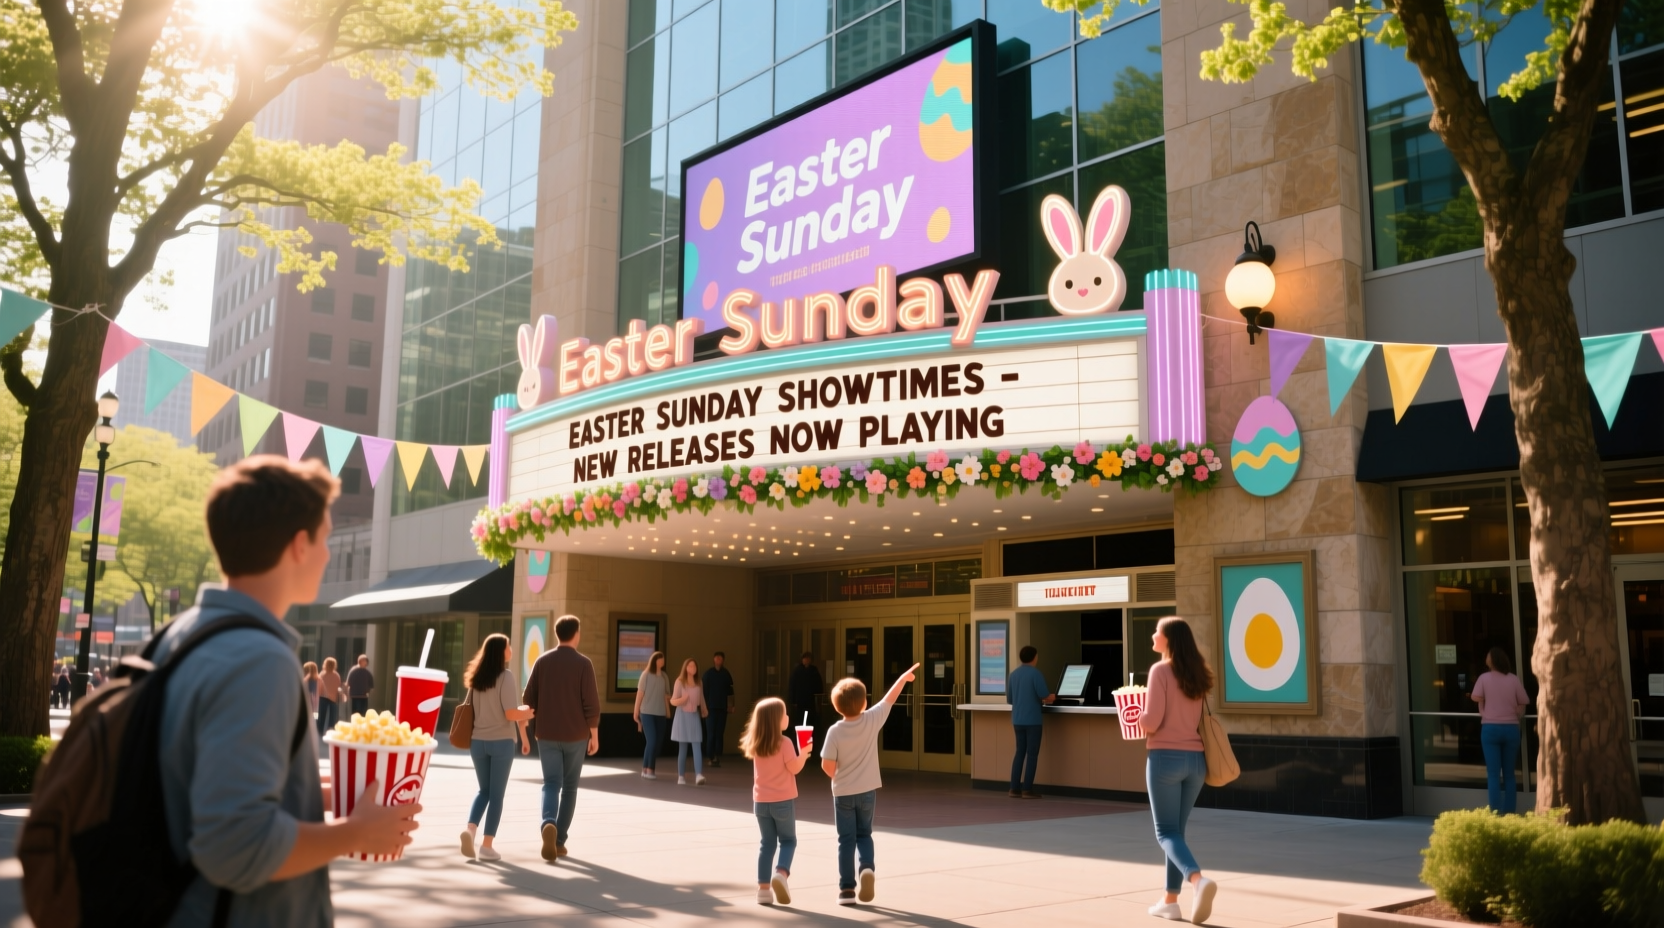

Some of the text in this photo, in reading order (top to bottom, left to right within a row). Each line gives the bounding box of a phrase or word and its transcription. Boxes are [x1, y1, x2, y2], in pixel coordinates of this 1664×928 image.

[744, 124, 892, 218] Easter
[736, 174, 915, 274] Sunday
[558, 317, 705, 395] Easter
[719, 264, 1000, 347] Sunday
[569, 406, 645, 450] EASTER
[656, 385, 763, 431] SUNDAY
[778, 362, 985, 413] SHOWTIMES
[573, 405, 1004, 484] NEW RELEASES NOW PLAYING
